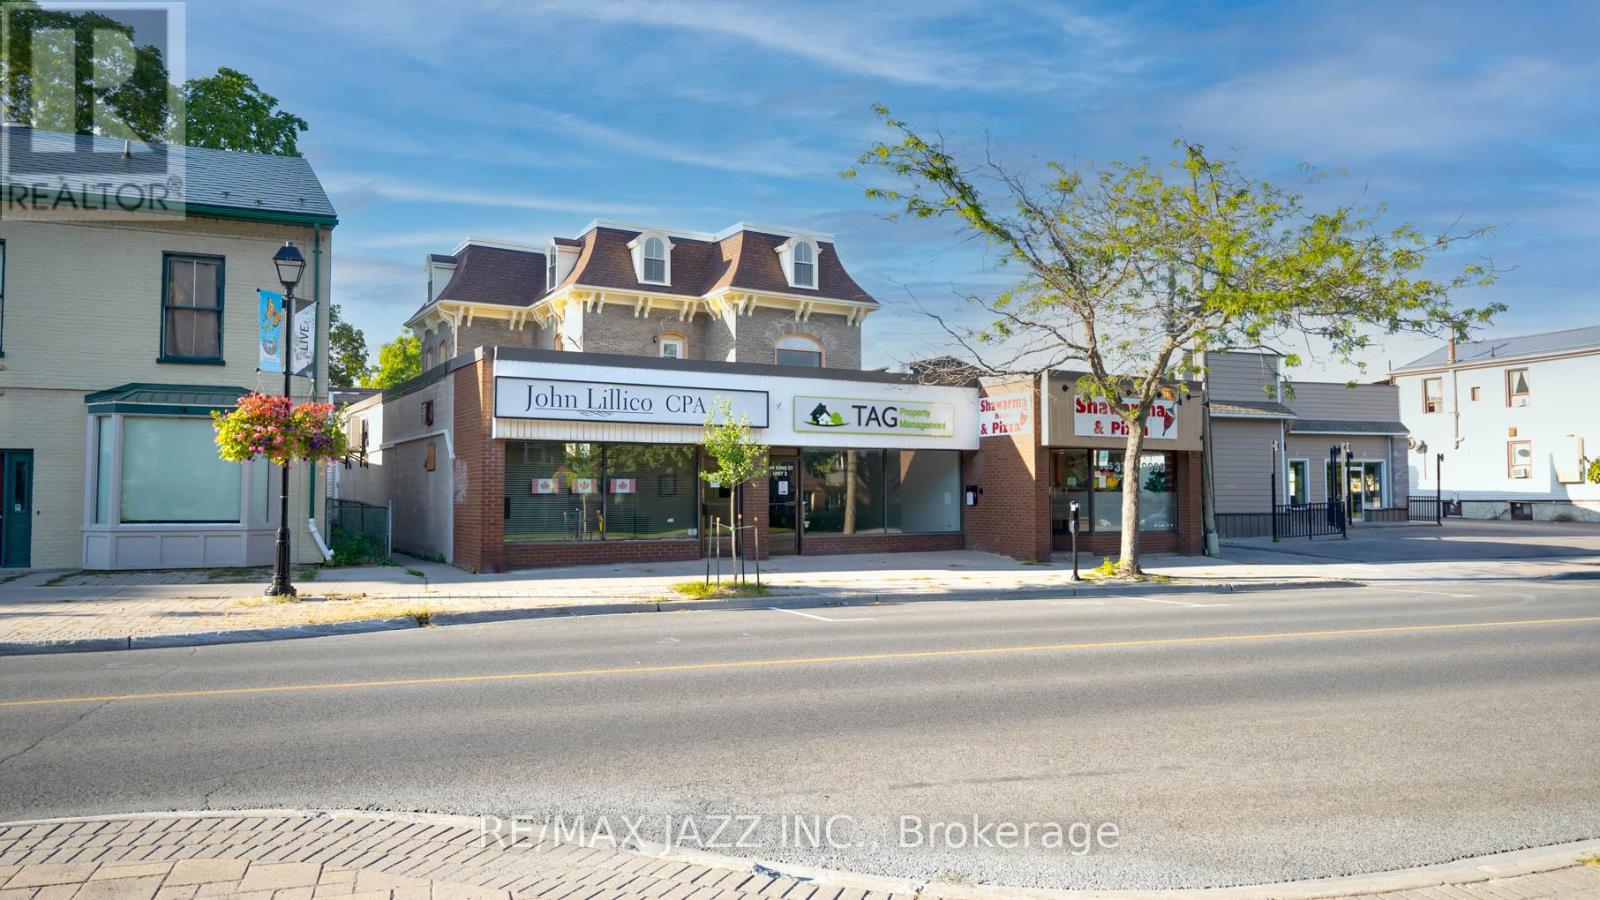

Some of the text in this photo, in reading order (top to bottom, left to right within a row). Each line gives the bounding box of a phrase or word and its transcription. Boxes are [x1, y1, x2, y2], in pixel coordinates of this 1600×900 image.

[299, 323, 310, 351] LIVE
[525, 384, 707, 414] John Lillico CPA
[980, 398, 1027, 412] Shawarma
[852, 404, 898, 428] TAG
[899, 407, 931, 418] Property
[899, 419, 946, 431] Management
[980, 420, 1021, 435] & Pizza
[1094, 420, 1104, 434] &
